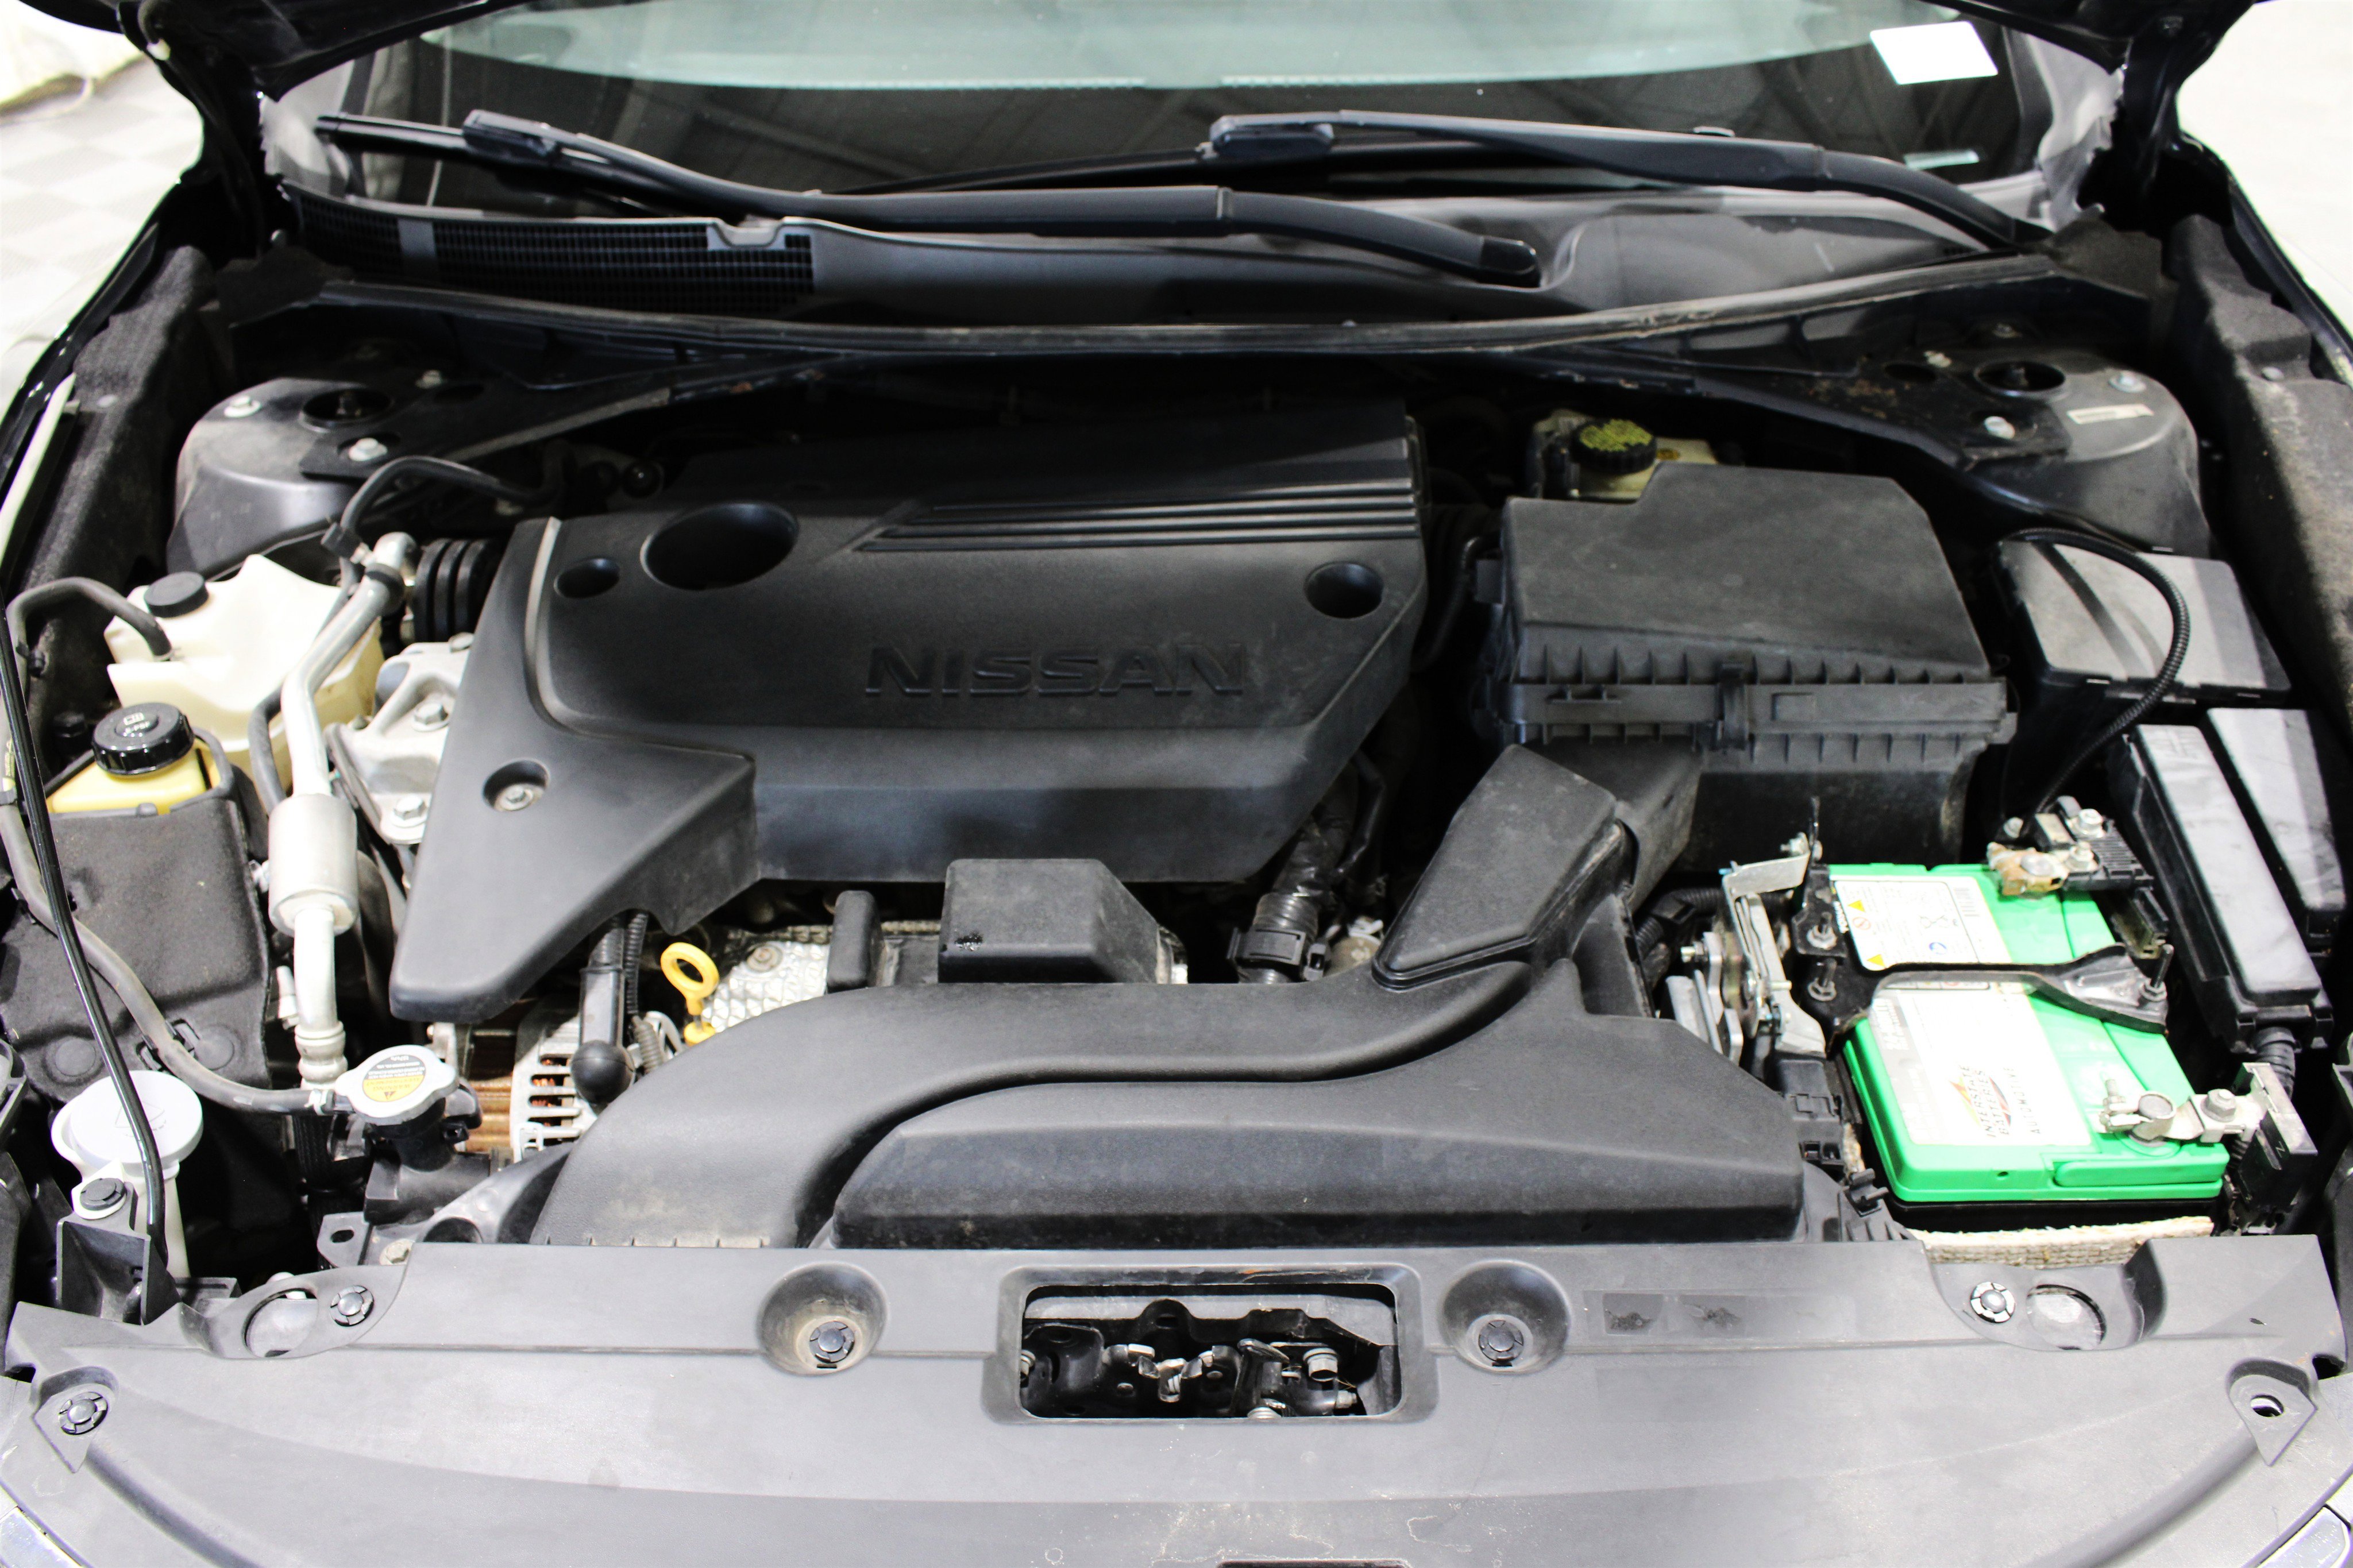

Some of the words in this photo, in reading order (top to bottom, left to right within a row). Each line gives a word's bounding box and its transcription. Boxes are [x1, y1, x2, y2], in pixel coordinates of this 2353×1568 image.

[865, 643, 1245, 696] NISSAN
[1958, 1064, 1997, 1138] INTERSTATE
[1975, 1068, 2010, 1136] BATTERIES
[2003, 1066, 2041, 1135] AUTOMOTIVE
